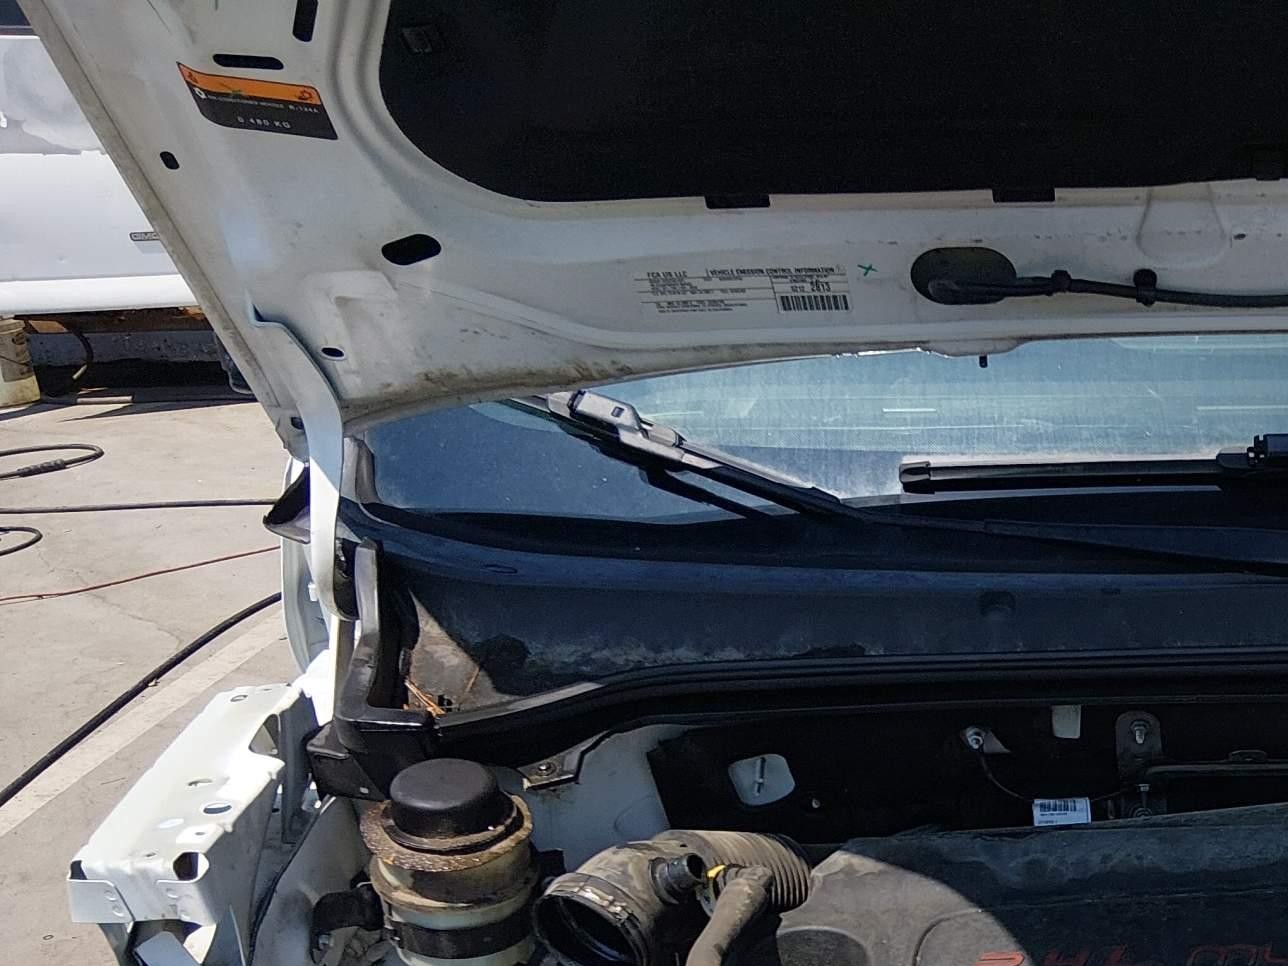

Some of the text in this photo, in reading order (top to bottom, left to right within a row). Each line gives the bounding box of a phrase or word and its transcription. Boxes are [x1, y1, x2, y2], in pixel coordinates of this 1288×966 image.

[709, 268, 734, 277] VEHICLE
[766, 266, 792, 275] CONTROL
[794, 266, 835, 274] INFORMATION
